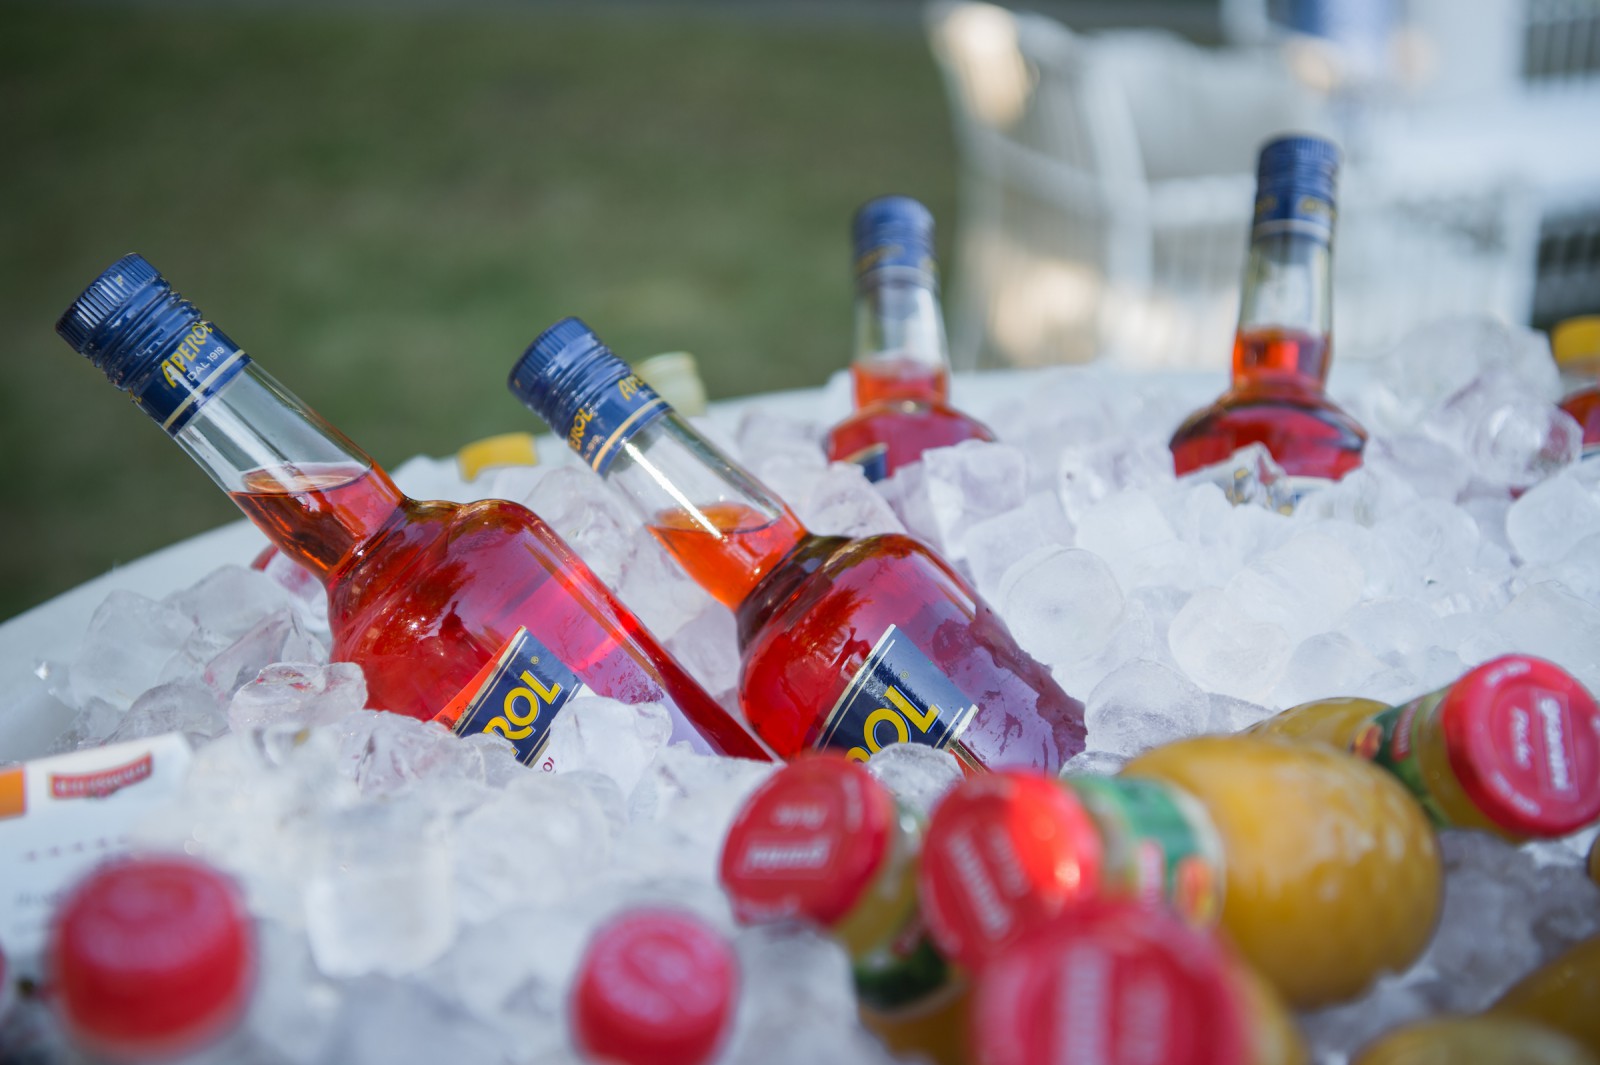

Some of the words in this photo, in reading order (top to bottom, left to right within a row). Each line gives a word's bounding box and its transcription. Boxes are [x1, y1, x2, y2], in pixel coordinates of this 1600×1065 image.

[187, 361, 210, 382] DAL
[207, 345, 225, 364] 1919
[482, 669, 563, 757] ROL
